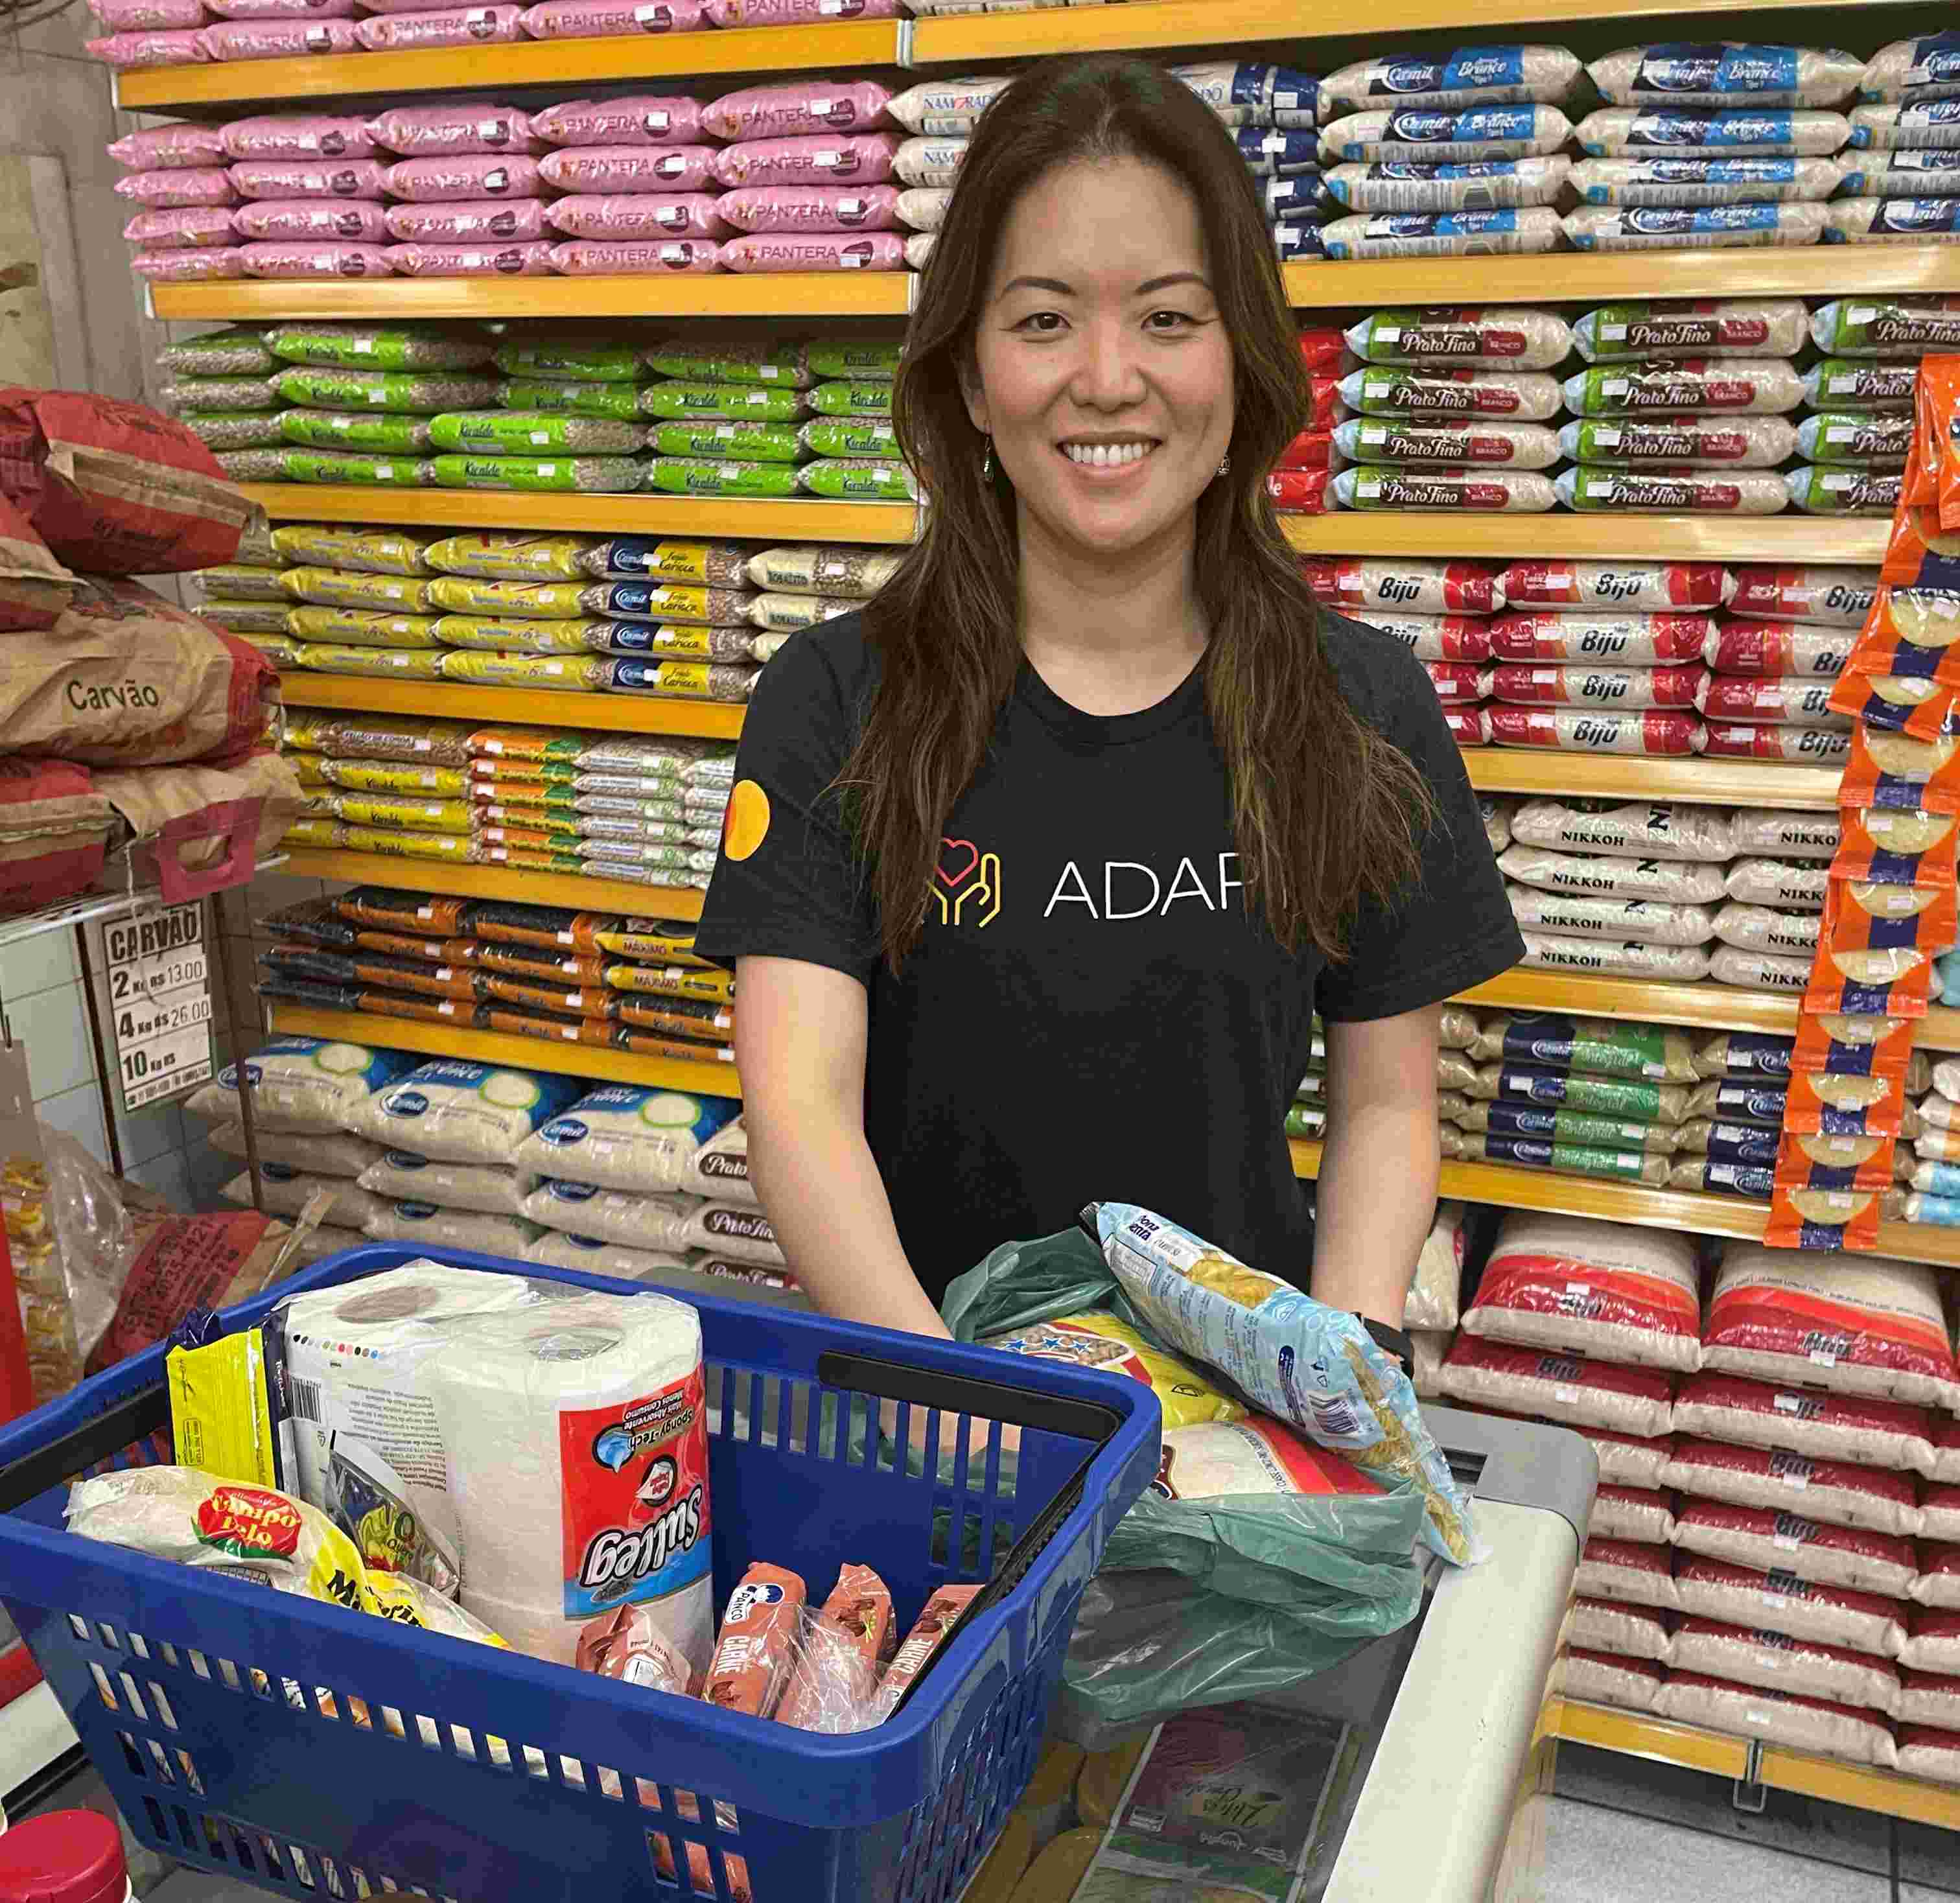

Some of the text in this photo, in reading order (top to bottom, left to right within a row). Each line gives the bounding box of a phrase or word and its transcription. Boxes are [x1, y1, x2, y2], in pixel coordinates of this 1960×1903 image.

[587, 248, 658, 261] PANTERA
[762, 246, 838, 260] PANTERA
[1378, 576, 1421, 603] Biju
[1595, 574, 1642, 601] Biju
[1825, 585, 1873, 613] Biju
[1581, 631, 1626, 653] Biju
[66, 678, 159, 712] Carvão
[1582, 675, 1627, 699] Biju
[1573, 721, 1618, 747] Biju
[1798, 731, 1845, 755] Biju
[1561, 830, 1625, 847] NIKKOH
[1780, 832, 1836, 846] NIKKO
[1552, 872, 1615, 891] NIKKOH
[1540, 914, 1603, 929] NIKKOH
[1540, 951, 1602, 968] NIKKOH
[113, 971, 130, 999] 2
[119, 1010, 135, 1038] 4
[123, 1049, 148, 1082] 10
[624, 1399, 663, 1420] Consumo
[580, 1484, 702, 1587] Sulleg
[731, 1591, 750, 1621] PANCO
